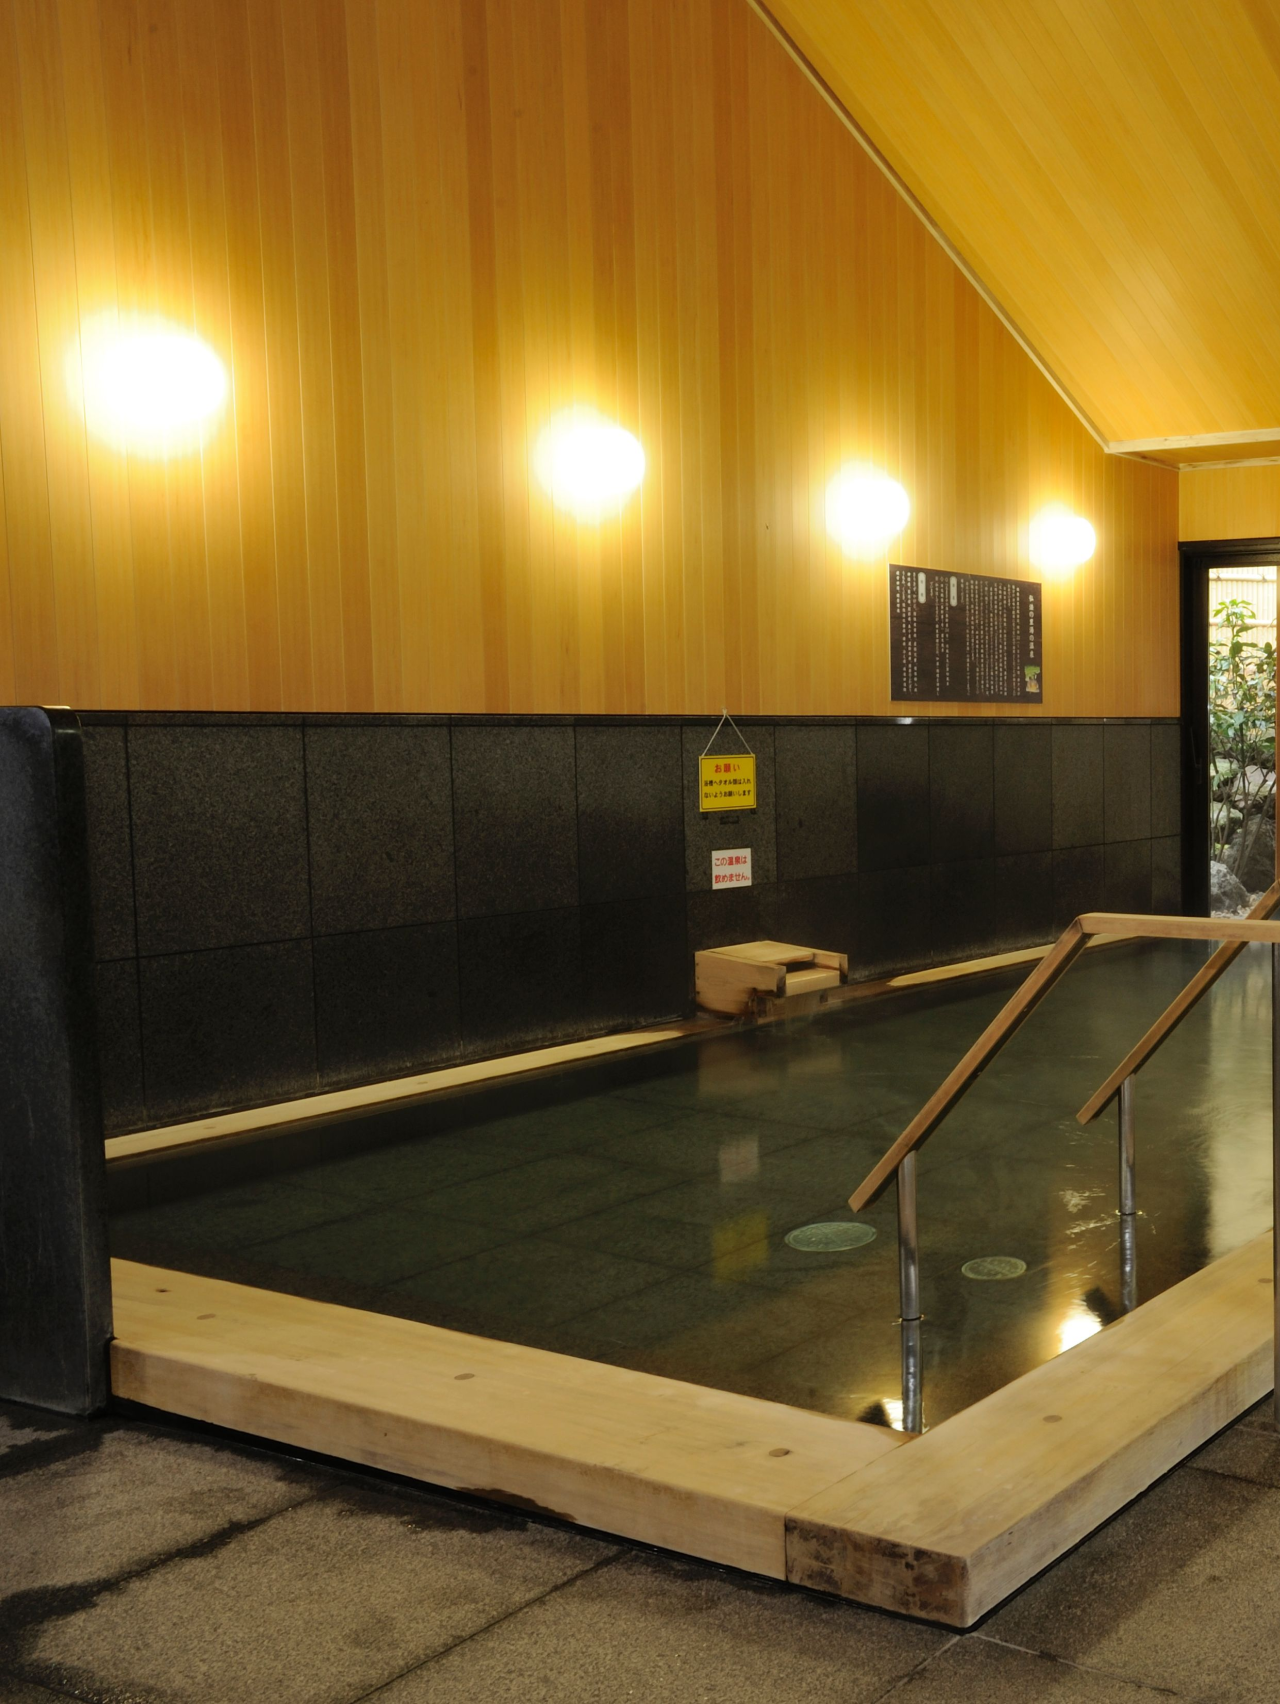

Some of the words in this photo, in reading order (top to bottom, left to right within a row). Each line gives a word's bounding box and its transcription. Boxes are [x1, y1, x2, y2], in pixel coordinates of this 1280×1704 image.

[714, 763, 741, 774] お願い
[704, 789, 752, 799] ないようお願いします
[714, 855, 748, 867] この温泉は
[714, 872, 750, 884] 飲めません。
